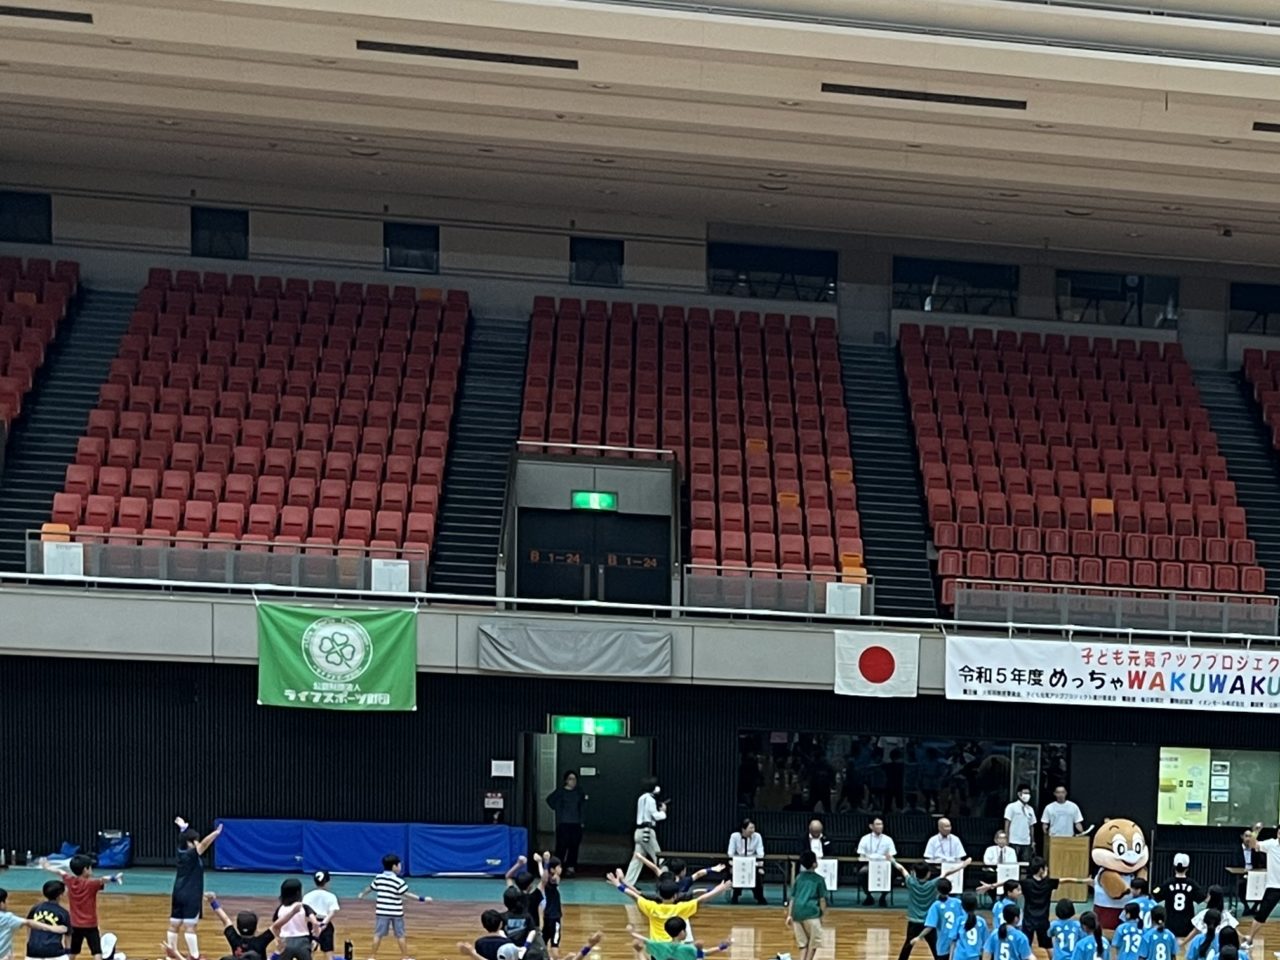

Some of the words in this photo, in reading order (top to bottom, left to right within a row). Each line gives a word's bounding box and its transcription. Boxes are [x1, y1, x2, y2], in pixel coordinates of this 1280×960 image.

[1173, 892, 1186, 911] 8
[944, 911, 955, 929] 3
[966, 927, 978, 946] 9
[1057, 932, 1075, 952] 11
[1123, 933, 1142, 953] 13
